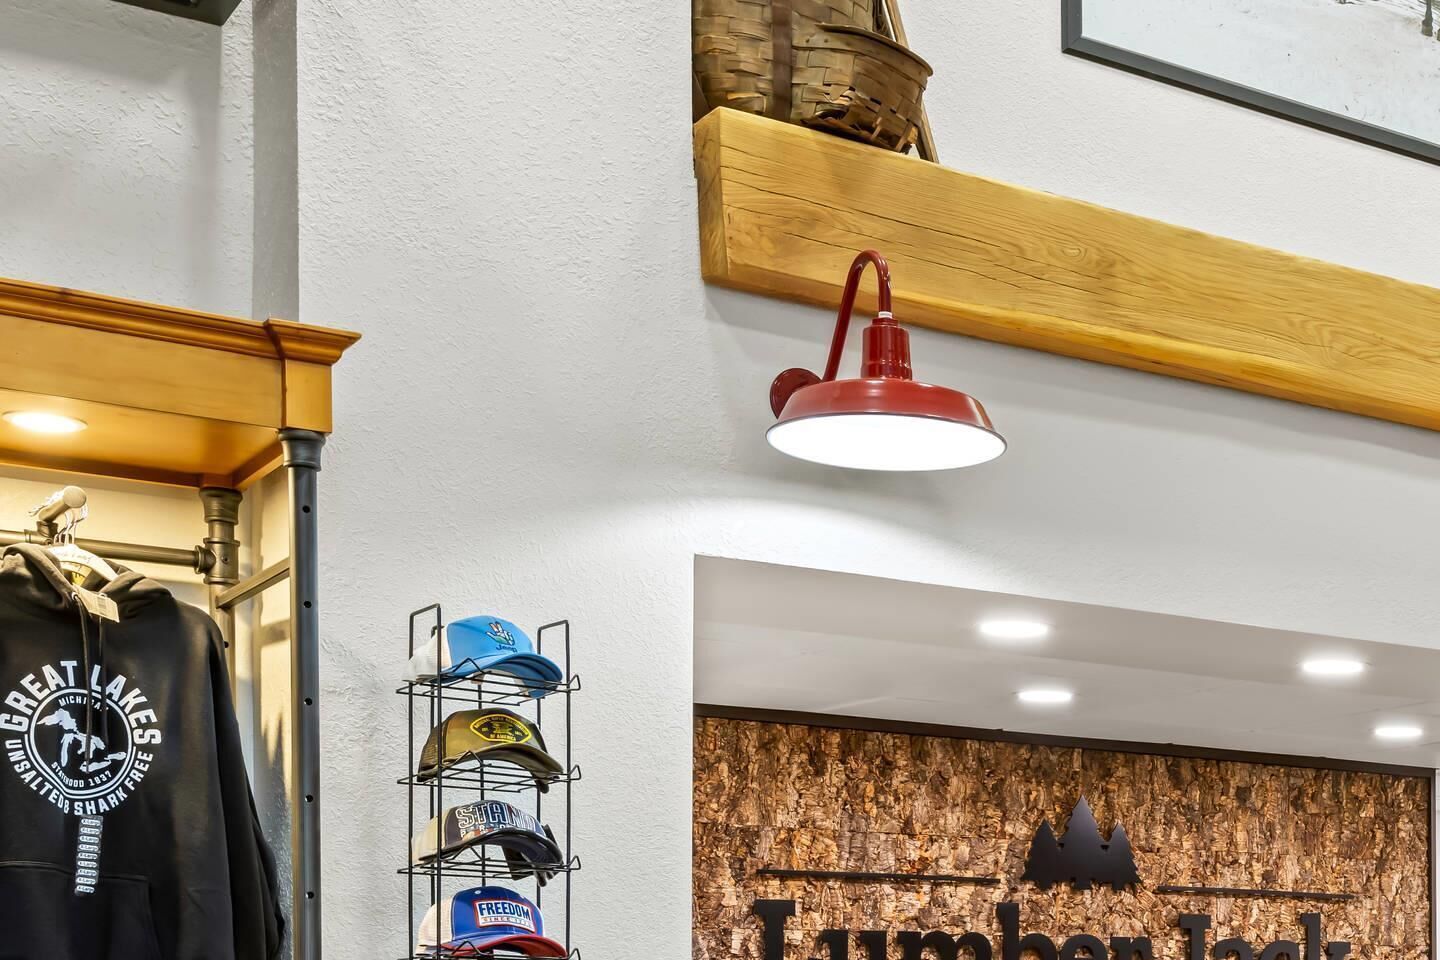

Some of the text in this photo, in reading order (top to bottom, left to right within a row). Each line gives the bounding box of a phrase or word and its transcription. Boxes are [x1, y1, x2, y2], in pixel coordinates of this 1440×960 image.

[0, 661, 162, 744] GREAT LAKES
[58, 695, 109, 712] MICHIA
[74, 789, 128, 816] SHARK
[125, 751, 153, 791] FREE
[478, 901, 531, 921] FREEDOM
